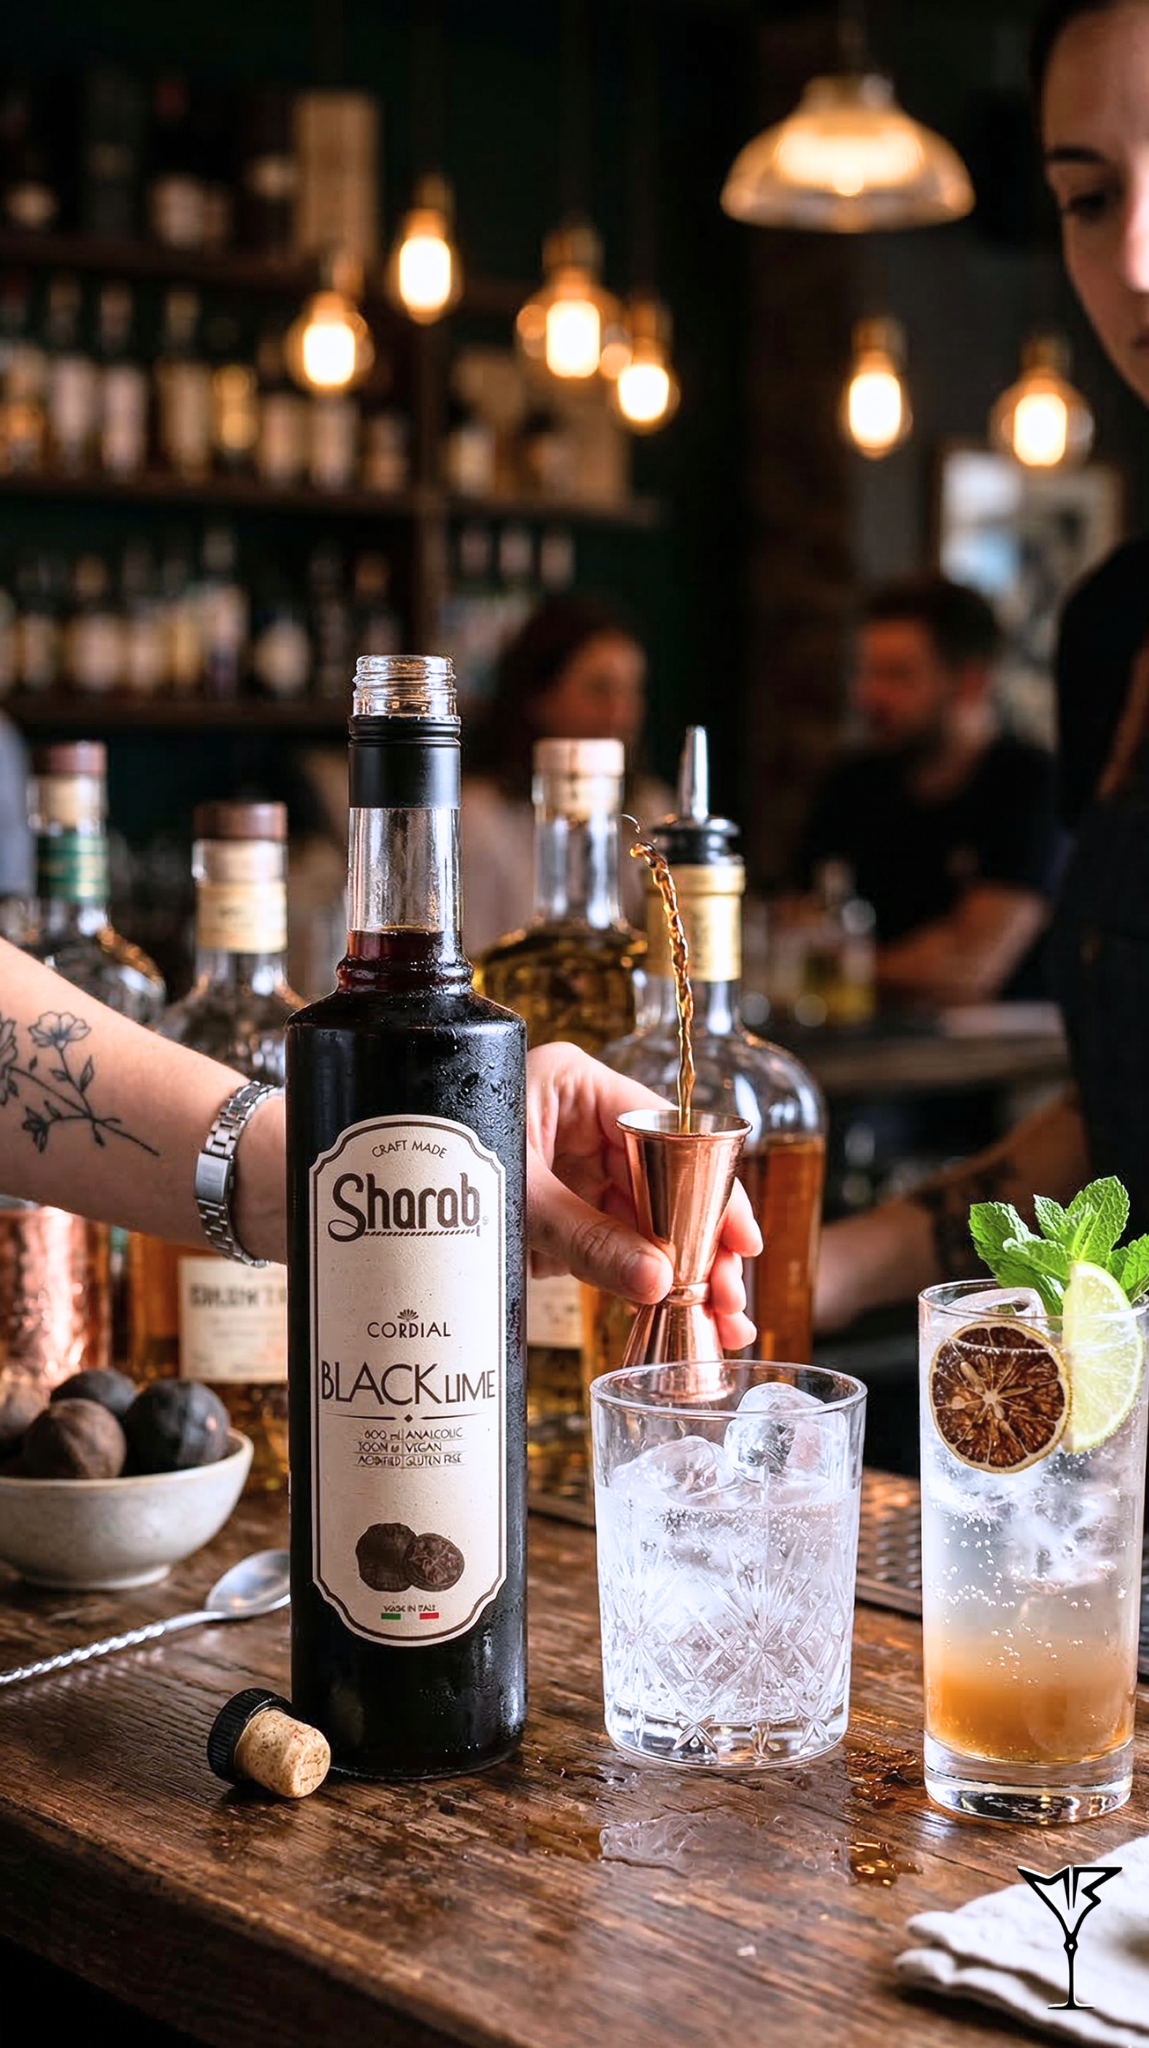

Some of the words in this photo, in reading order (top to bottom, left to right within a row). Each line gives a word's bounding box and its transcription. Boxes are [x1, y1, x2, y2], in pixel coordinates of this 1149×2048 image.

[371, 1140, 408, 1158] CRAFT
[411, 1140, 447, 1159] MADE
[327, 1172, 481, 1242] Sharab
[367, 1321, 452, 1338] CORDIAL
[321, 1360, 442, 1405] BLACK
[445, 1369, 496, 1404] LIME
